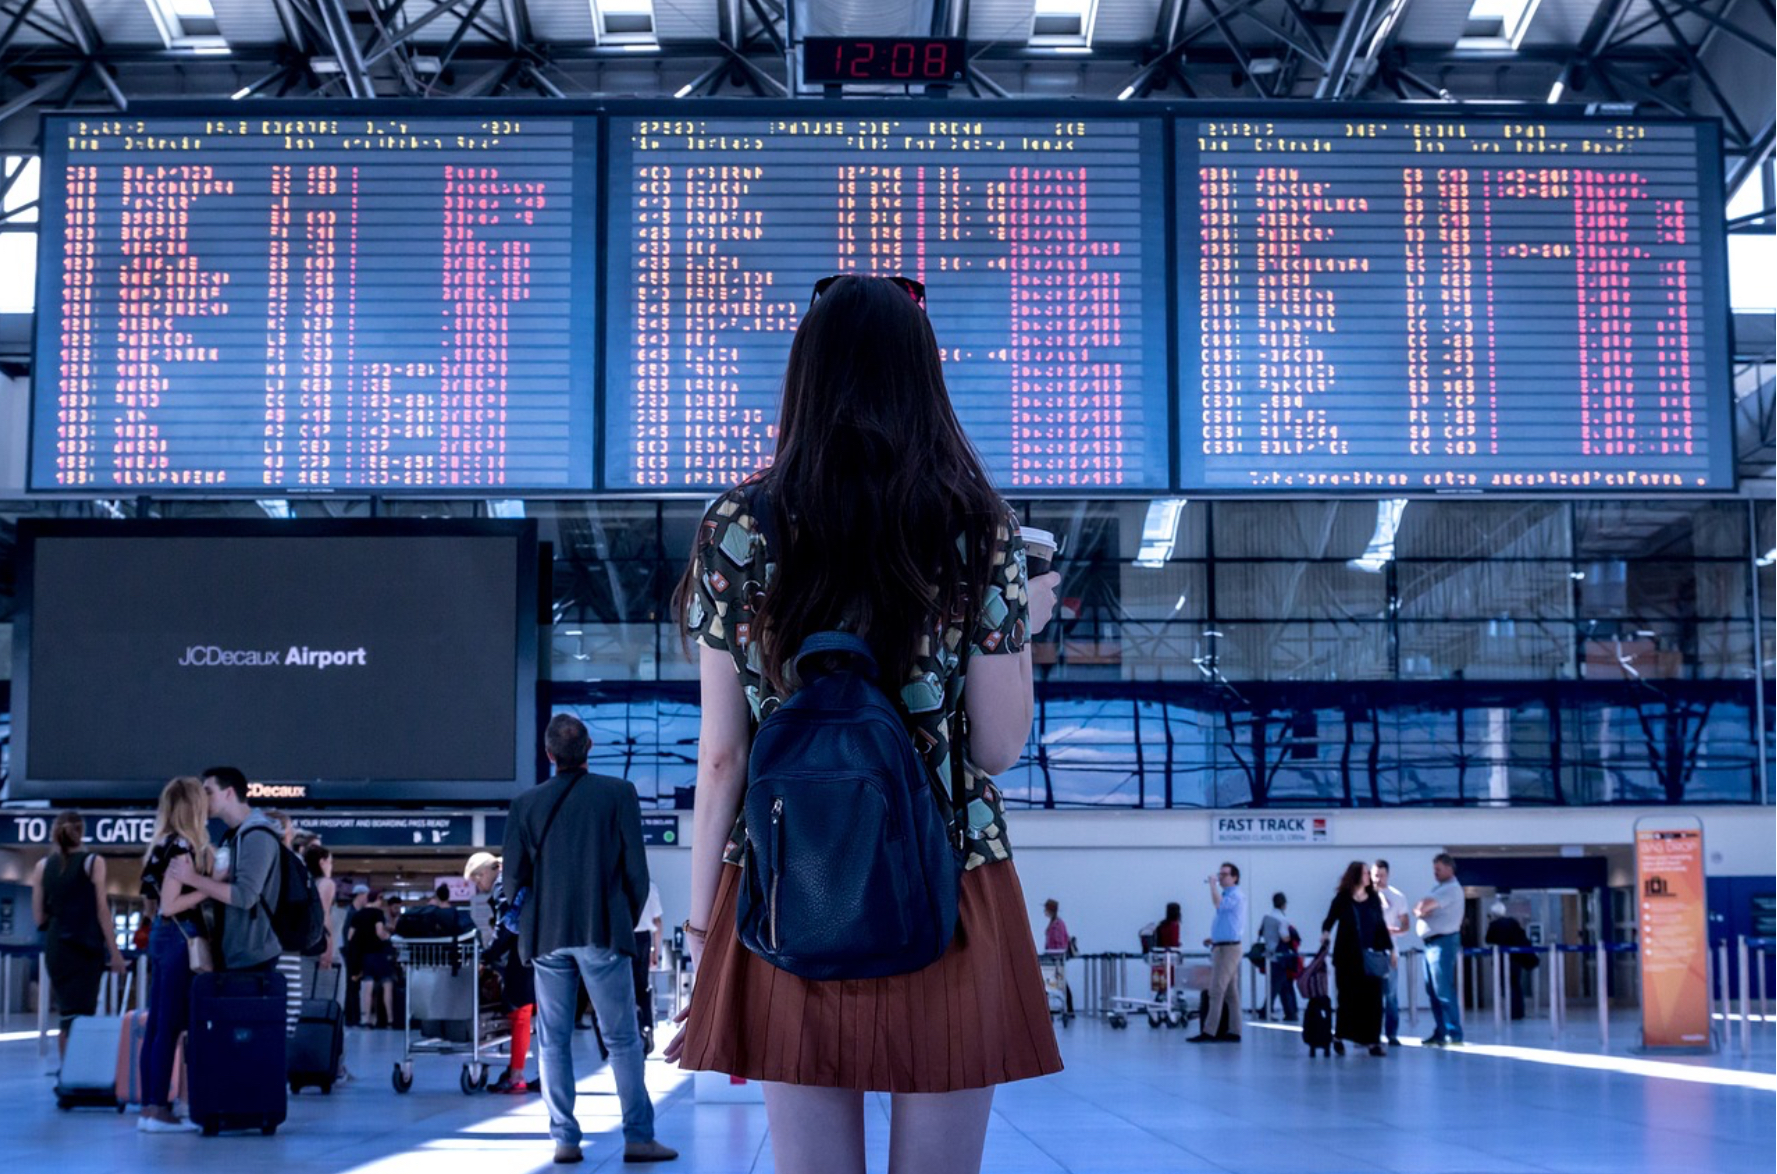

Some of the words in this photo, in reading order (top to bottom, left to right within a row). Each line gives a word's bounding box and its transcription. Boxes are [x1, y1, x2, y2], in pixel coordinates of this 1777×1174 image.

[835, 43, 947, 77] 12:08
[178, 646, 280, 666] JCDecaux
[284, 646, 367, 669] Airport
[246, 783, 306, 798] CDecaux
[14, 818, 46, 842] TO
[96, 818, 155, 842] GATE
[1219, 818, 1253, 831] FAST
[1257, 818, 1305, 831] TRACK
